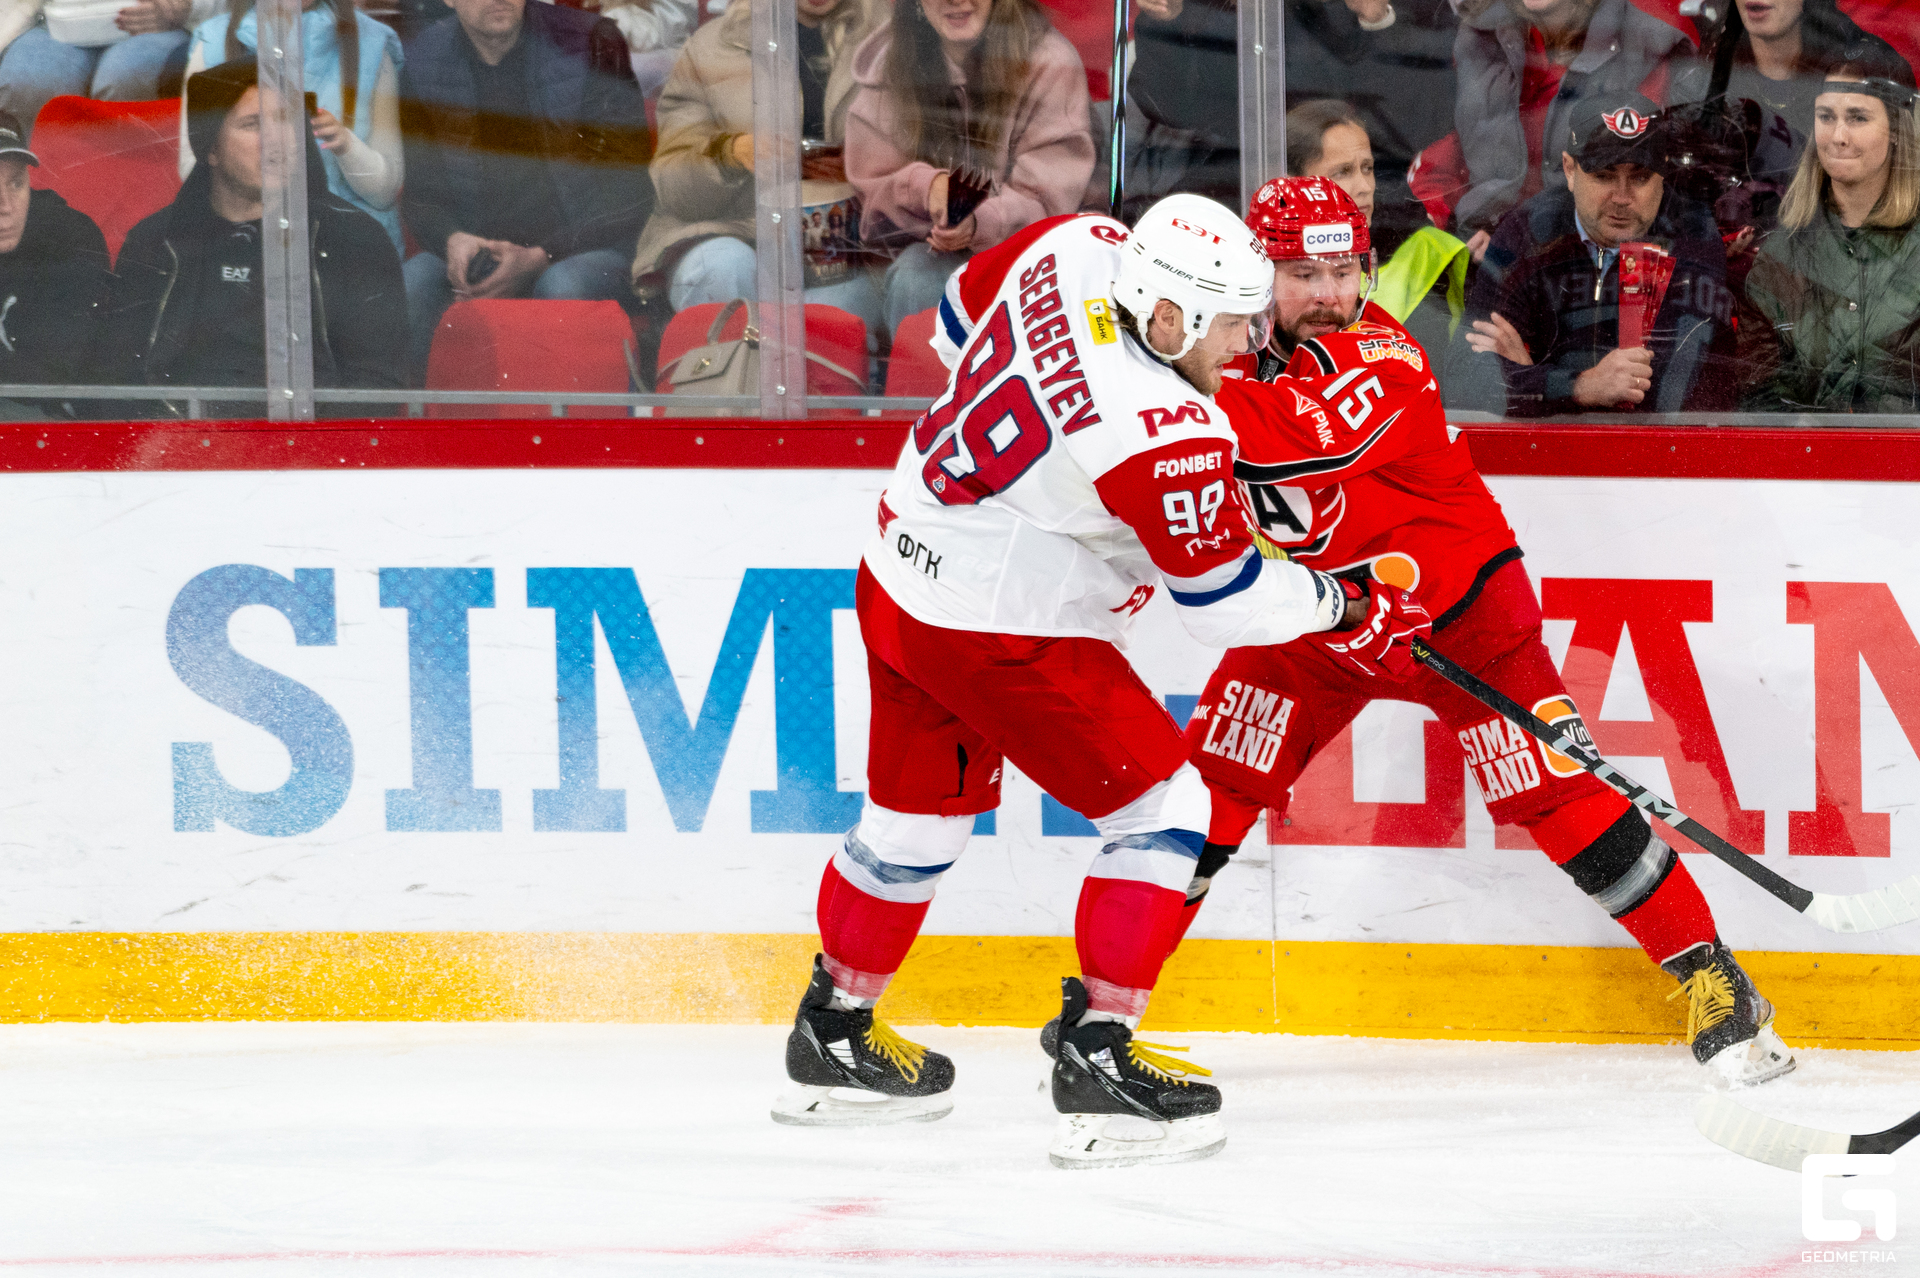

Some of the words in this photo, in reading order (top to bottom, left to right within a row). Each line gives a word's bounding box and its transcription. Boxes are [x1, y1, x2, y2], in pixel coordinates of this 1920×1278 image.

[1300, 187, 1329, 202] 15
[222, 266, 250, 279] EA7
[1019, 253, 1102, 436] SERGEYEV
[1095, 316, 1108, 340] БАНК
[1359, 339, 1421, 359] УГМК
[914, 300, 1053, 506] 99
[1321, 367, 1385, 431] 15
[1153, 451, 1223, 479] FONBET
[1162, 478, 1225, 536] 99
[897, 533, 942, 579] ФГК
[1325, 593, 1391, 653] CCM
[1217, 680, 1295, 736] SIMA
[1202, 714, 1282, 774] LAND
[1458, 716, 1529, 767] SIMA
[1472, 749, 1541, 804] LAND
